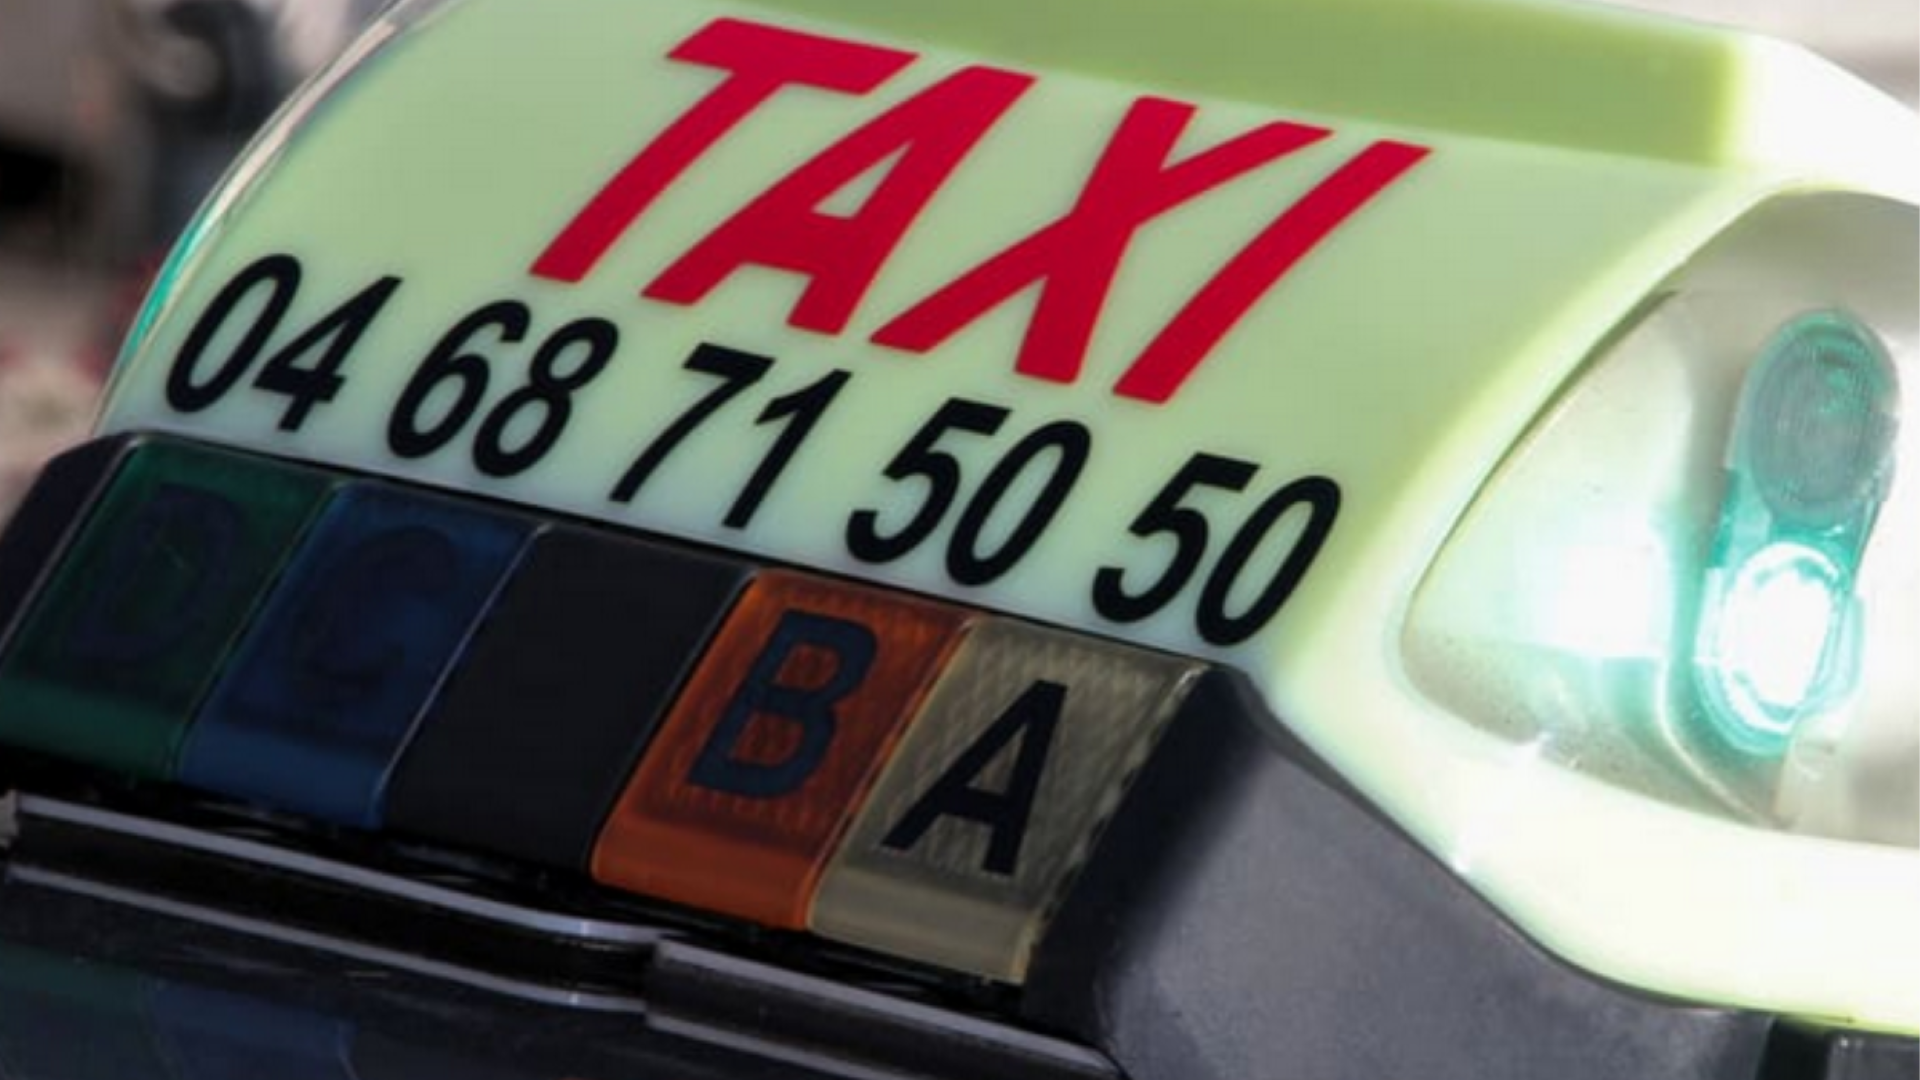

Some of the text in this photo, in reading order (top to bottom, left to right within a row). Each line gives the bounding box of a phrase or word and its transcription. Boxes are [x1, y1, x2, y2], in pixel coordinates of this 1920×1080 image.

[530, 17, 1431, 405] TAXI
[164, 253, 1342, 650] 04 68 71 50 50
[68, 482, 246, 666] D
[687, 609, 878, 797] B
[882, 680, 1067, 875] A
